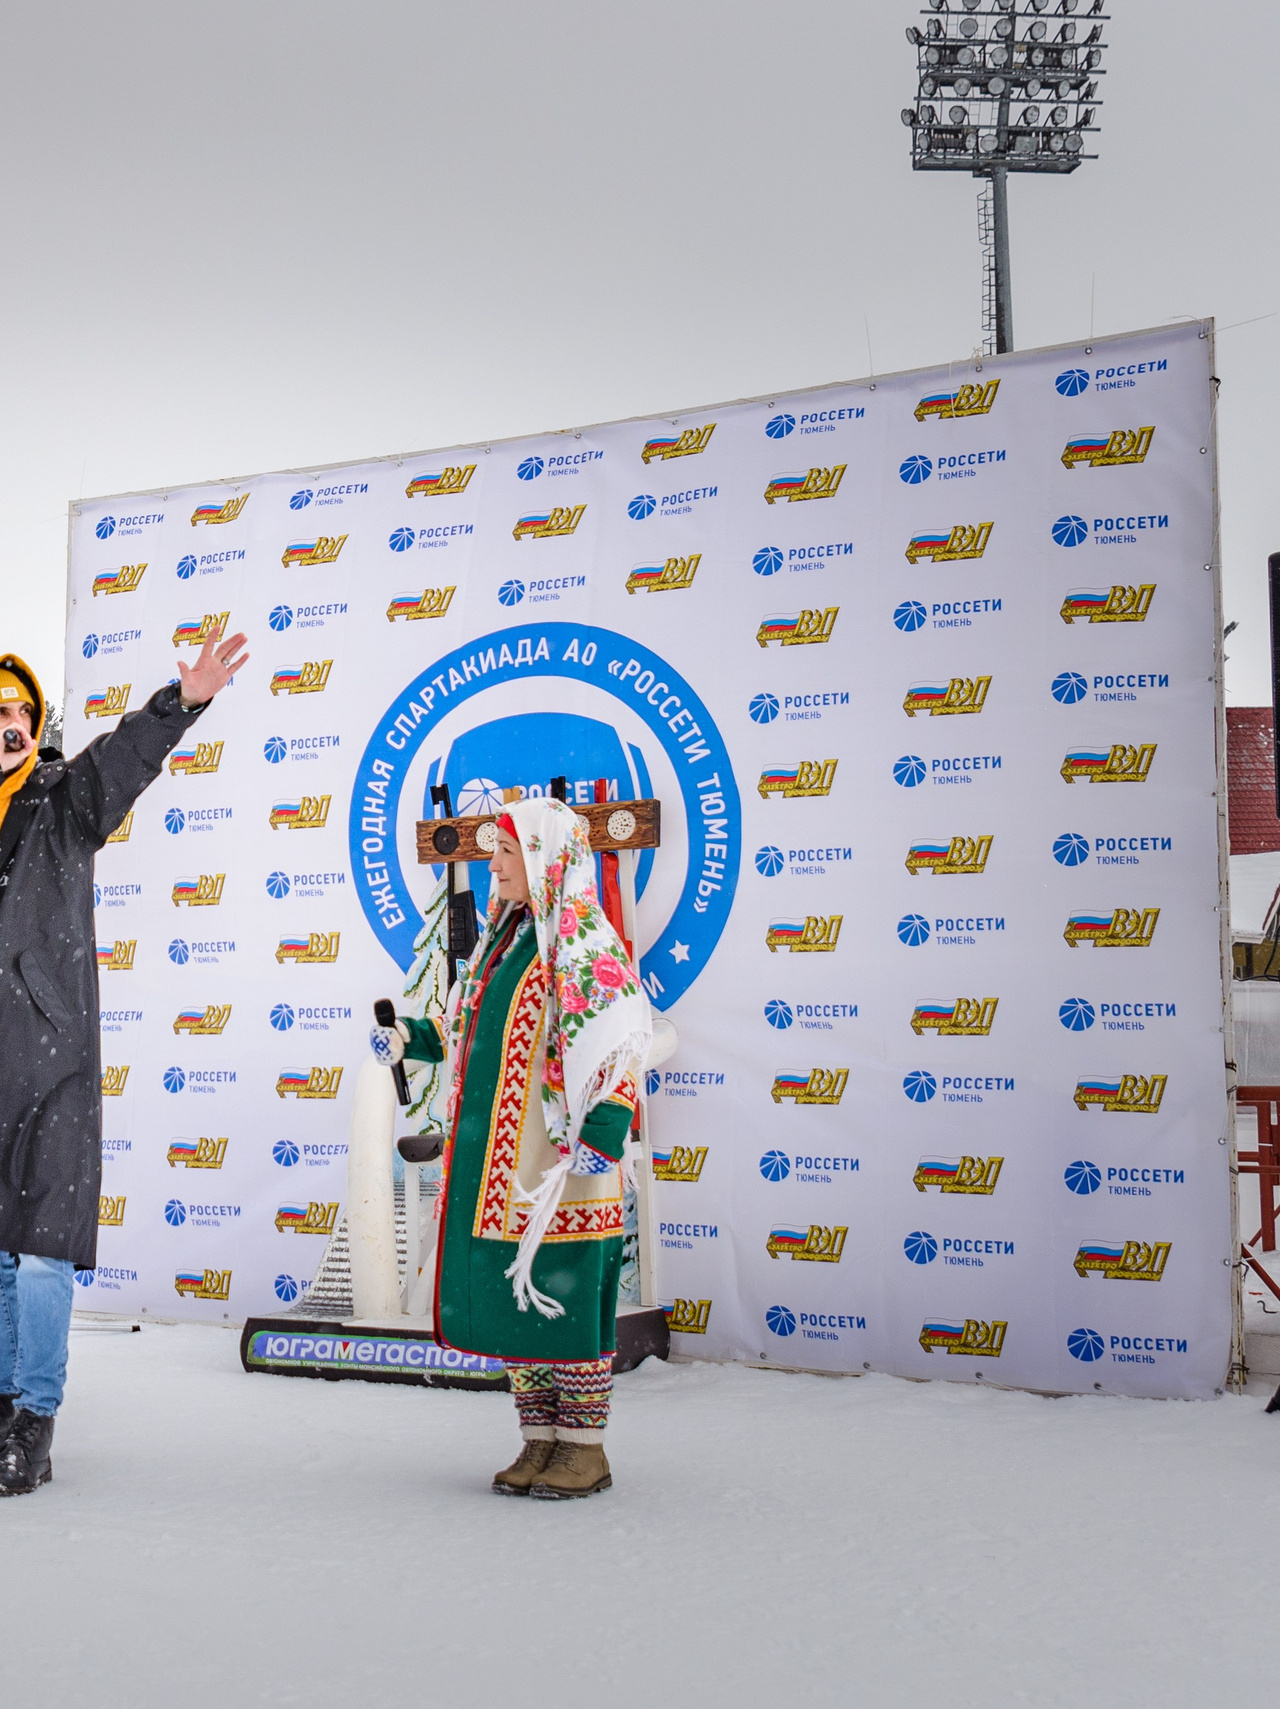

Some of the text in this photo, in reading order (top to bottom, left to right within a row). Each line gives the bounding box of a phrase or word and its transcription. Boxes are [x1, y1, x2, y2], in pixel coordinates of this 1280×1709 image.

[1095, 360, 1168, 380] РОССЕТИ
[1095, 379, 1136, 391] ТЮМЕНЬ
[800, 408, 865, 424] РОССЕТИ
[800, 425, 836, 435] ТЮМЕНЬ
[548, 451, 604, 467] РОССЕТИ
[938, 450, 1006, 469] РОССЕТИ
[938, 467, 976, 480] ТЮМЕНЬ
[317, 483, 369, 497] РОССЕТИ
[661, 486, 719, 506] РОССЕТИ
[119, 513, 165, 526] РОССЕТИ
[1093, 515, 1169, 531] РОССЕТИ
[419, 524, 474, 539] РОССЕТИ
[1094, 534, 1137, 546] ТЮМЕНЬ
[200, 550, 246, 565] РОССЕТИ
[789, 543, 853, 560] РОССЕТИ
[788, 562, 826, 572] ТЮМЕНЬ
[529, 575, 586, 591] РОССЕТИ
[297, 603, 348, 617] РОССЕТИ
[932, 599, 1002, 616] РОССЕТИ
[932, 618, 972, 629] ТЮМЕНЬ
[101, 630, 142, 644] РОССЕТИ
[1093, 674, 1169, 689] РОССЕТИ
[784, 693, 850, 708] РОССЕТИ
[1094, 692, 1136, 702] ТЮМЕНЬ
[785, 710, 821, 721] ТЮМЕНЬ
[291, 735, 340, 750] РОССЕТИ
[932, 756, 1002, 772] РОССЕТИ
[361, 637, 728, 929] ЕЖЕГОДНАЯ СПАРТАКИАДА АО «РОССЕТИ ТЮМЕНЬ»
[932, 775, 972, 785] ТЮМЕНЬ
[188, 807, 232, 821] РОССЕТИ
[1095, 837, 1172, 851] РОССЕТИ
[789, 848, 852, 862] РОССЕТИ
[1096, 855, 1139, 866] ТЮМЕНЬ
[789, 866, 827, 876] ТЮМЕНЬ
[294, 873, 346, 885] РОССЕТИ
[103, 884, 141, 896] РОССЕТИ
[935, 917, 1005, 932] РОССЕТИ
[192, 941, 236, 953] РОССЕТИ
[936, 935, 976, 946] ТЮМЕНЬ
[298, 1007, 352, 1019] РОССЕТИ
[796, 1004, 859, 1018] РОССЕТИ
[1100, 1003, 1176, 1017] РОССЕТИ
[1102, 1019, 1145, 1032] ТЮМЕНЬ
[189, 1071, 237, 1083] РОССЕТИ
[665, 1072, 725, 1085] РОССЕТИ
[942, 1077, 1015, 1091] РОССЕТИ
[943, 1093, 984, 1104] ТЮМЕНЬ
[101, 1140, 132, 1151] ОССЕТИ
[795, 1156, 860, 1171] РОССЕТИ
[795, 1173, 832, 1184] ТЮМЕНЬ
[1107, 1167, 1185, 1184] РОССЕТИ
[1107, 1185, 1152, 1197] ТЮМЕНЬ
[189, 1205, 242, 1217] РОССЕТИ
[660, 1224, 719, 1238] РОССЕТИ
[943, 1239, 1014, 1255] РОССЕТИ
[943, 1256, 984, 1268] ТЮМЕНЬ
[97, 1267, 138, 1281] РОССЕТИ
[800, 1314, 866, 1329] РОССЕТИ
[1110, 1336, 1188, 1353] РОССЕТИ
[1112, 1353, 1156, 1365] ТЮМЕНЬ
